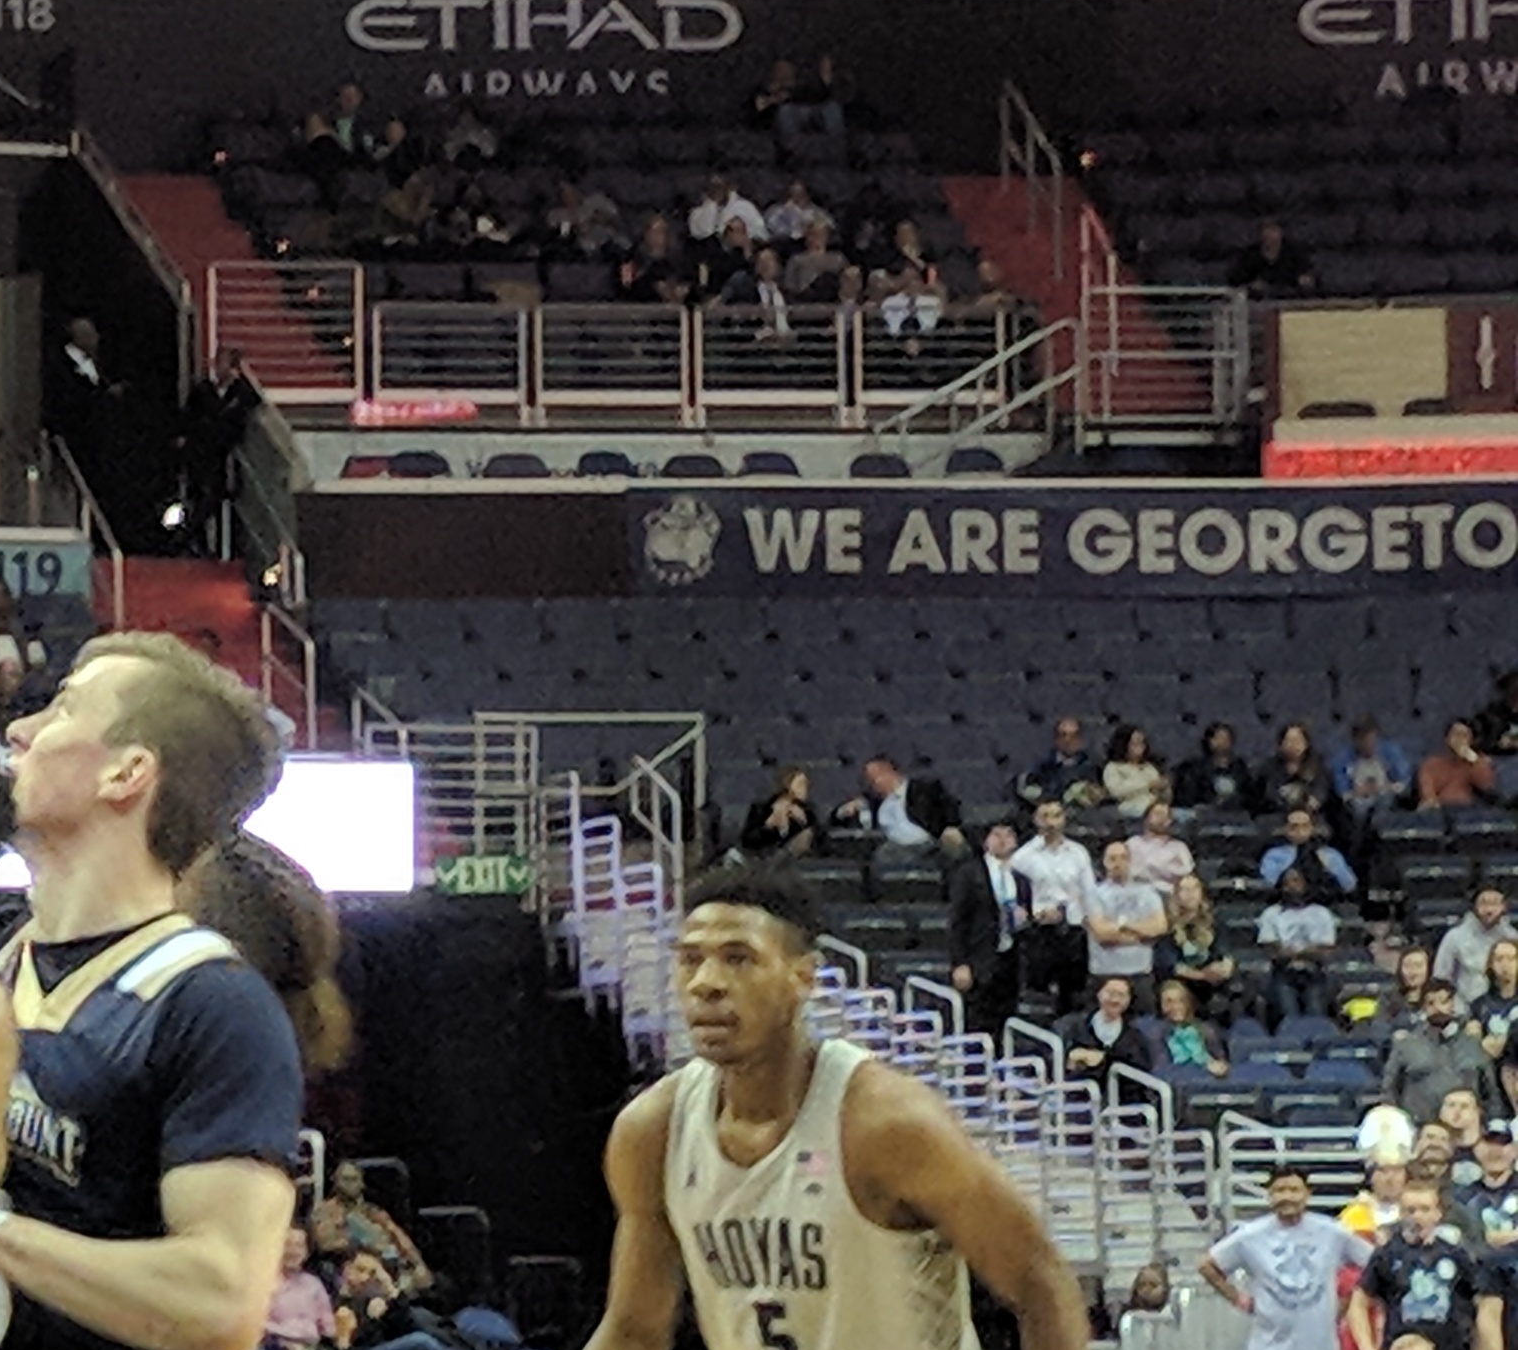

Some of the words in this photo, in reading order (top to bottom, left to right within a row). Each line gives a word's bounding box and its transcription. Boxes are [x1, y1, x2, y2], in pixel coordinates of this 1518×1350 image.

[424, 69, 670, 96] AIRWAYS
[743, 508, 862, 573] WE
[888, 509, 1040, 573] ARE
[1067, 502, 1518, 574] GEORGETO
[693, 1217, 827, 1290] HOYAS
